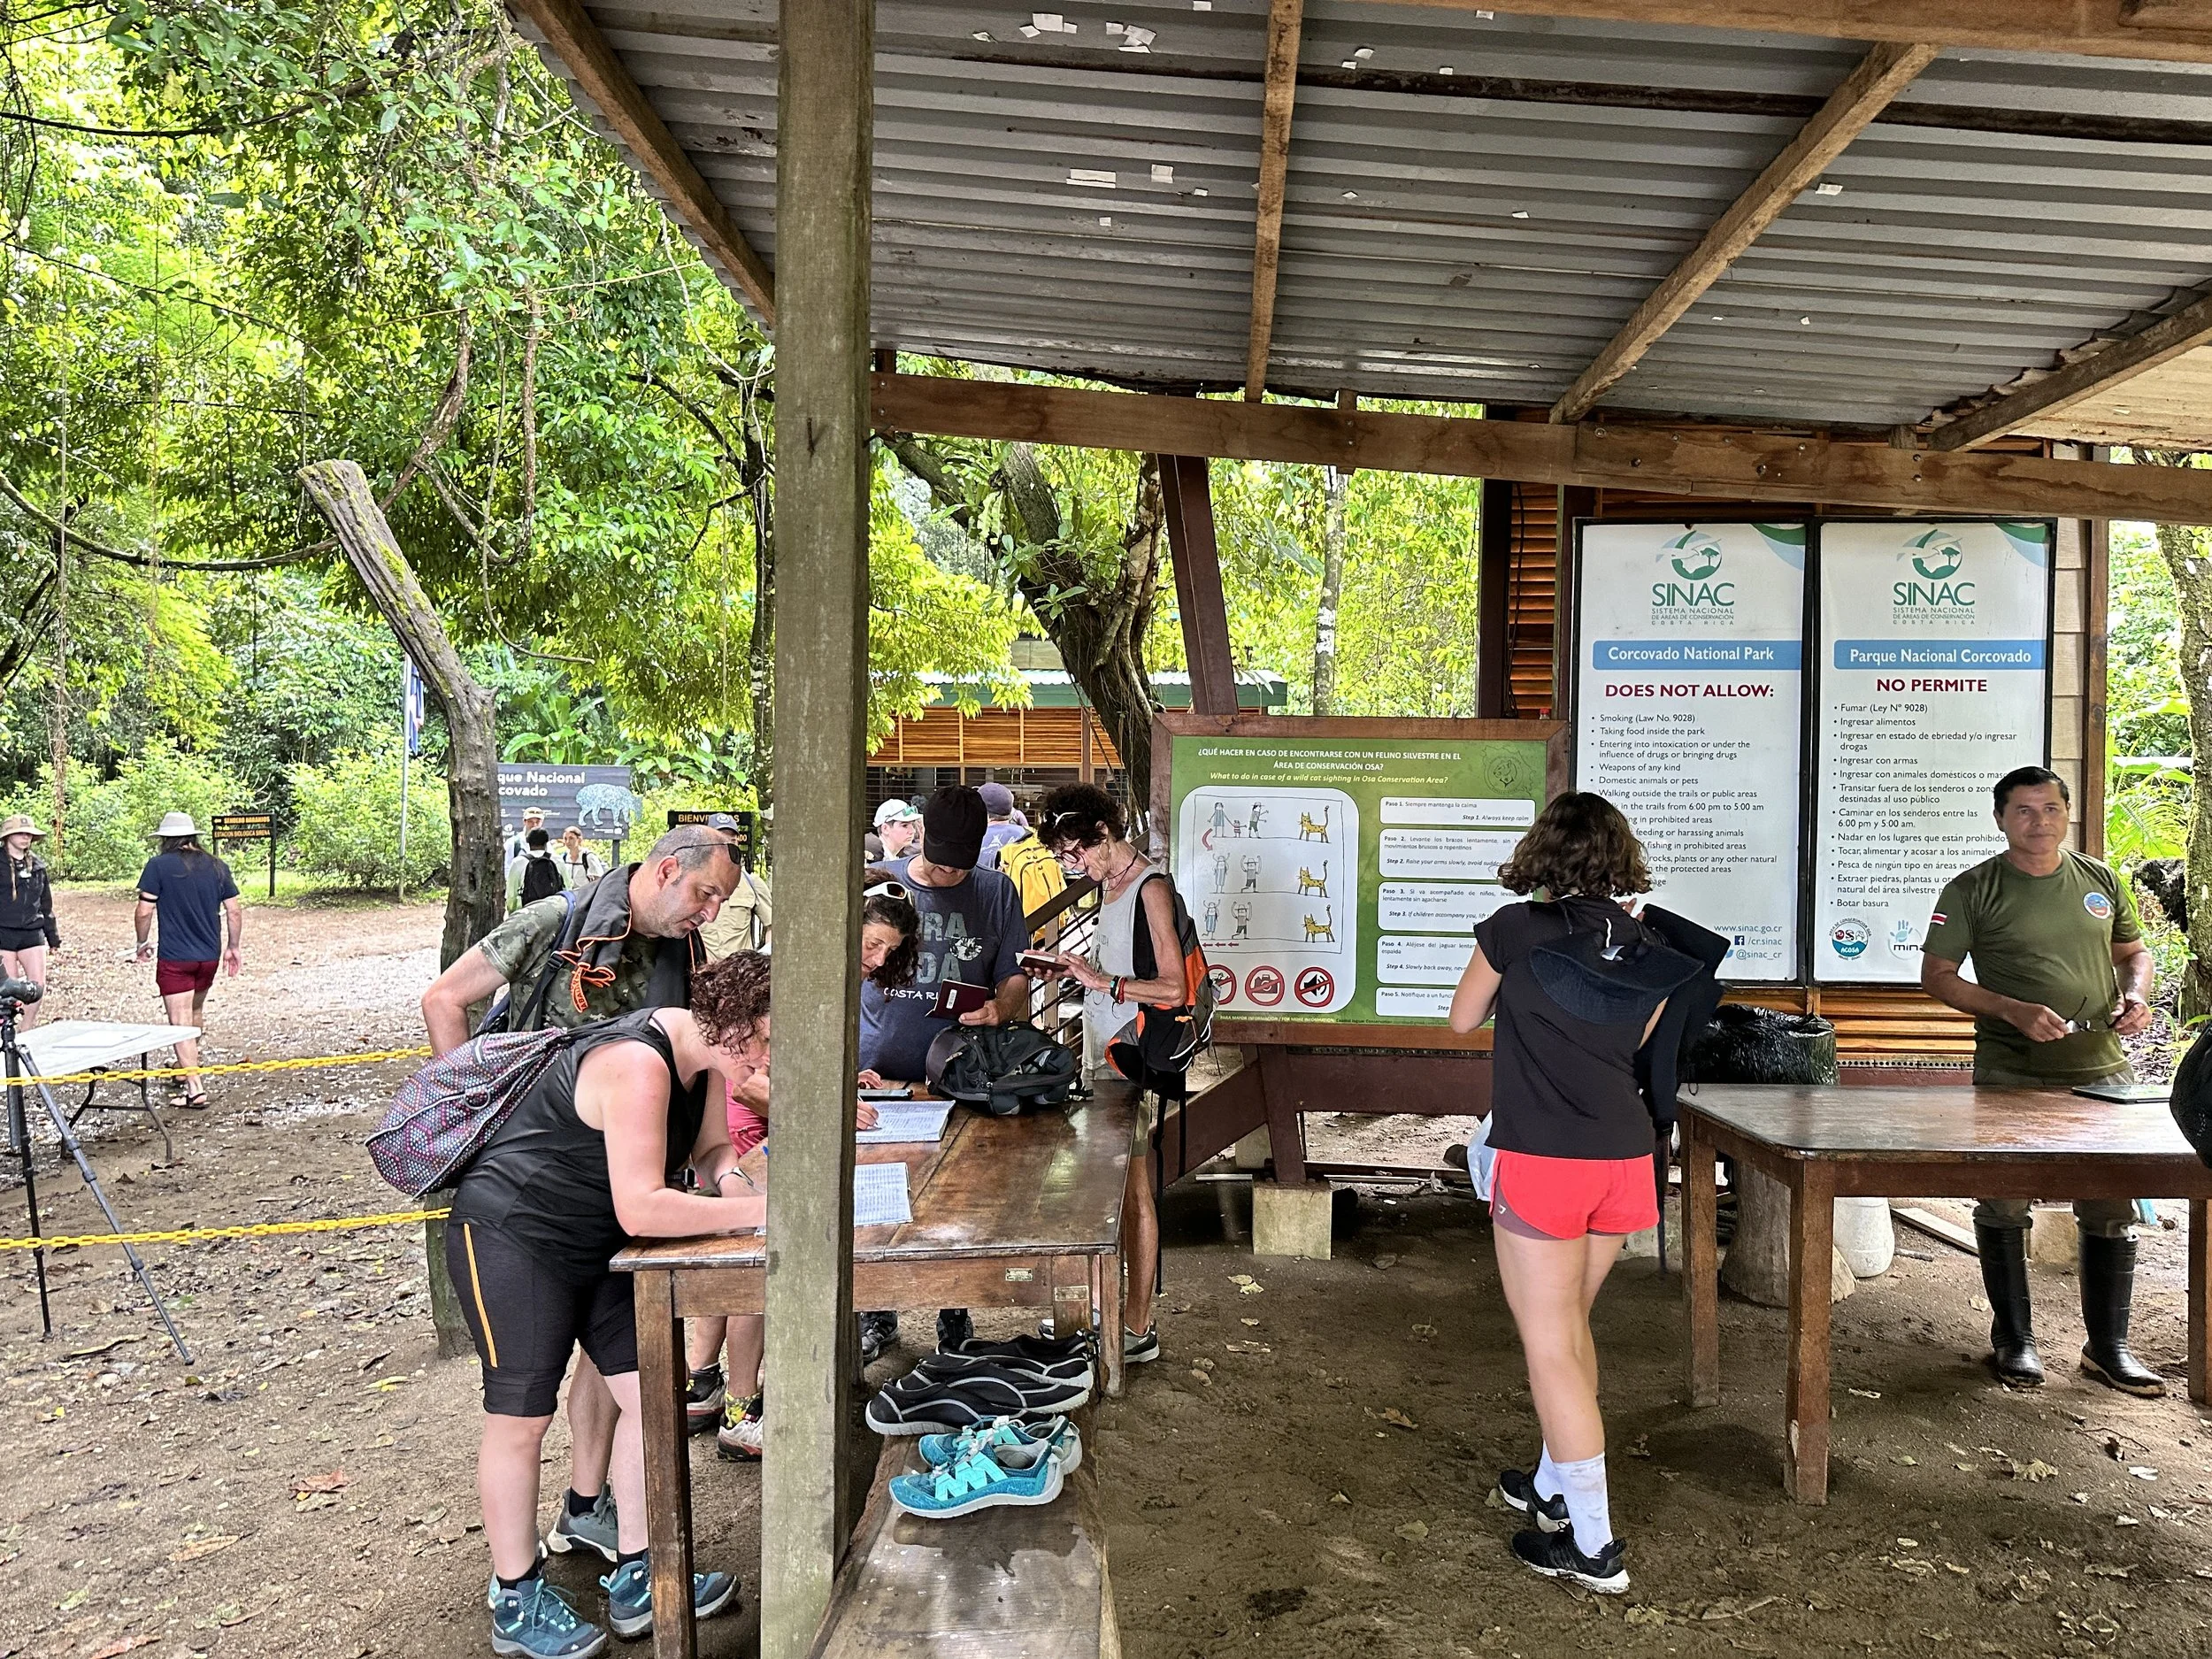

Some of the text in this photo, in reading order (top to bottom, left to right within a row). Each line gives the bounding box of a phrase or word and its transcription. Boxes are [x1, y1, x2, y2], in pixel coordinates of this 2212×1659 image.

[1653, 582, 1734, 606] SINAC
[1893, 582, 1975, 606] SINAC
[1609, 647, 1774, 660] Corcovado National Park
[1850, 649, 2032, 665] Parque Nacional Corcovado
[1877, 679, 1987, 691] NO PERMITE
[1606, 685, 1774, 696] DOES NOT ALLOW:
[1870, 704, 1887, 713] (Ley
[1904, 704, 1927, 713] 9028)
[1601, 714, 1632, 723] Smoking
[1673, 714, 1695, 723] 9028)
[1840, 718, 1873, 727] Ingresar
[1601, 727, 1624, 736] Taking
[1687, 727, 1705, 736] park
[1840, 732, 1873, 741] Ingresar
[1970, 732, 1982, 741] y/o
[1985, 733, 2016, 741] ingresar
[1600, 741, 1632, 749] Entering
[1840, 742, 1867, 752] drogas
[1647, 751, 1668, 760] drugs
[1683, 751, 1713, 760] bringing
[1717, 751, 1737, 760] drugs
[1840, 757, 1873, 765] Ingresar
[1600, 764, 1635, 772] Weapons
[497, 771, 585, 785] que Nacional
[498, 784, 548, 796] covado
[1599, 789, 1630, 798] Walking
[1910, 795, 1939, 804] público
[679, 814, 739, 823] BIENVS
[917, 911, 967, 941] RA
[1714, 925, 1782, 934] www.sinac.go.cr
[1736, 949, 1782, 960] @sinac_cr
[917, 952, 961, 984] DA
[884, 987, 923, 1000] COSTA
